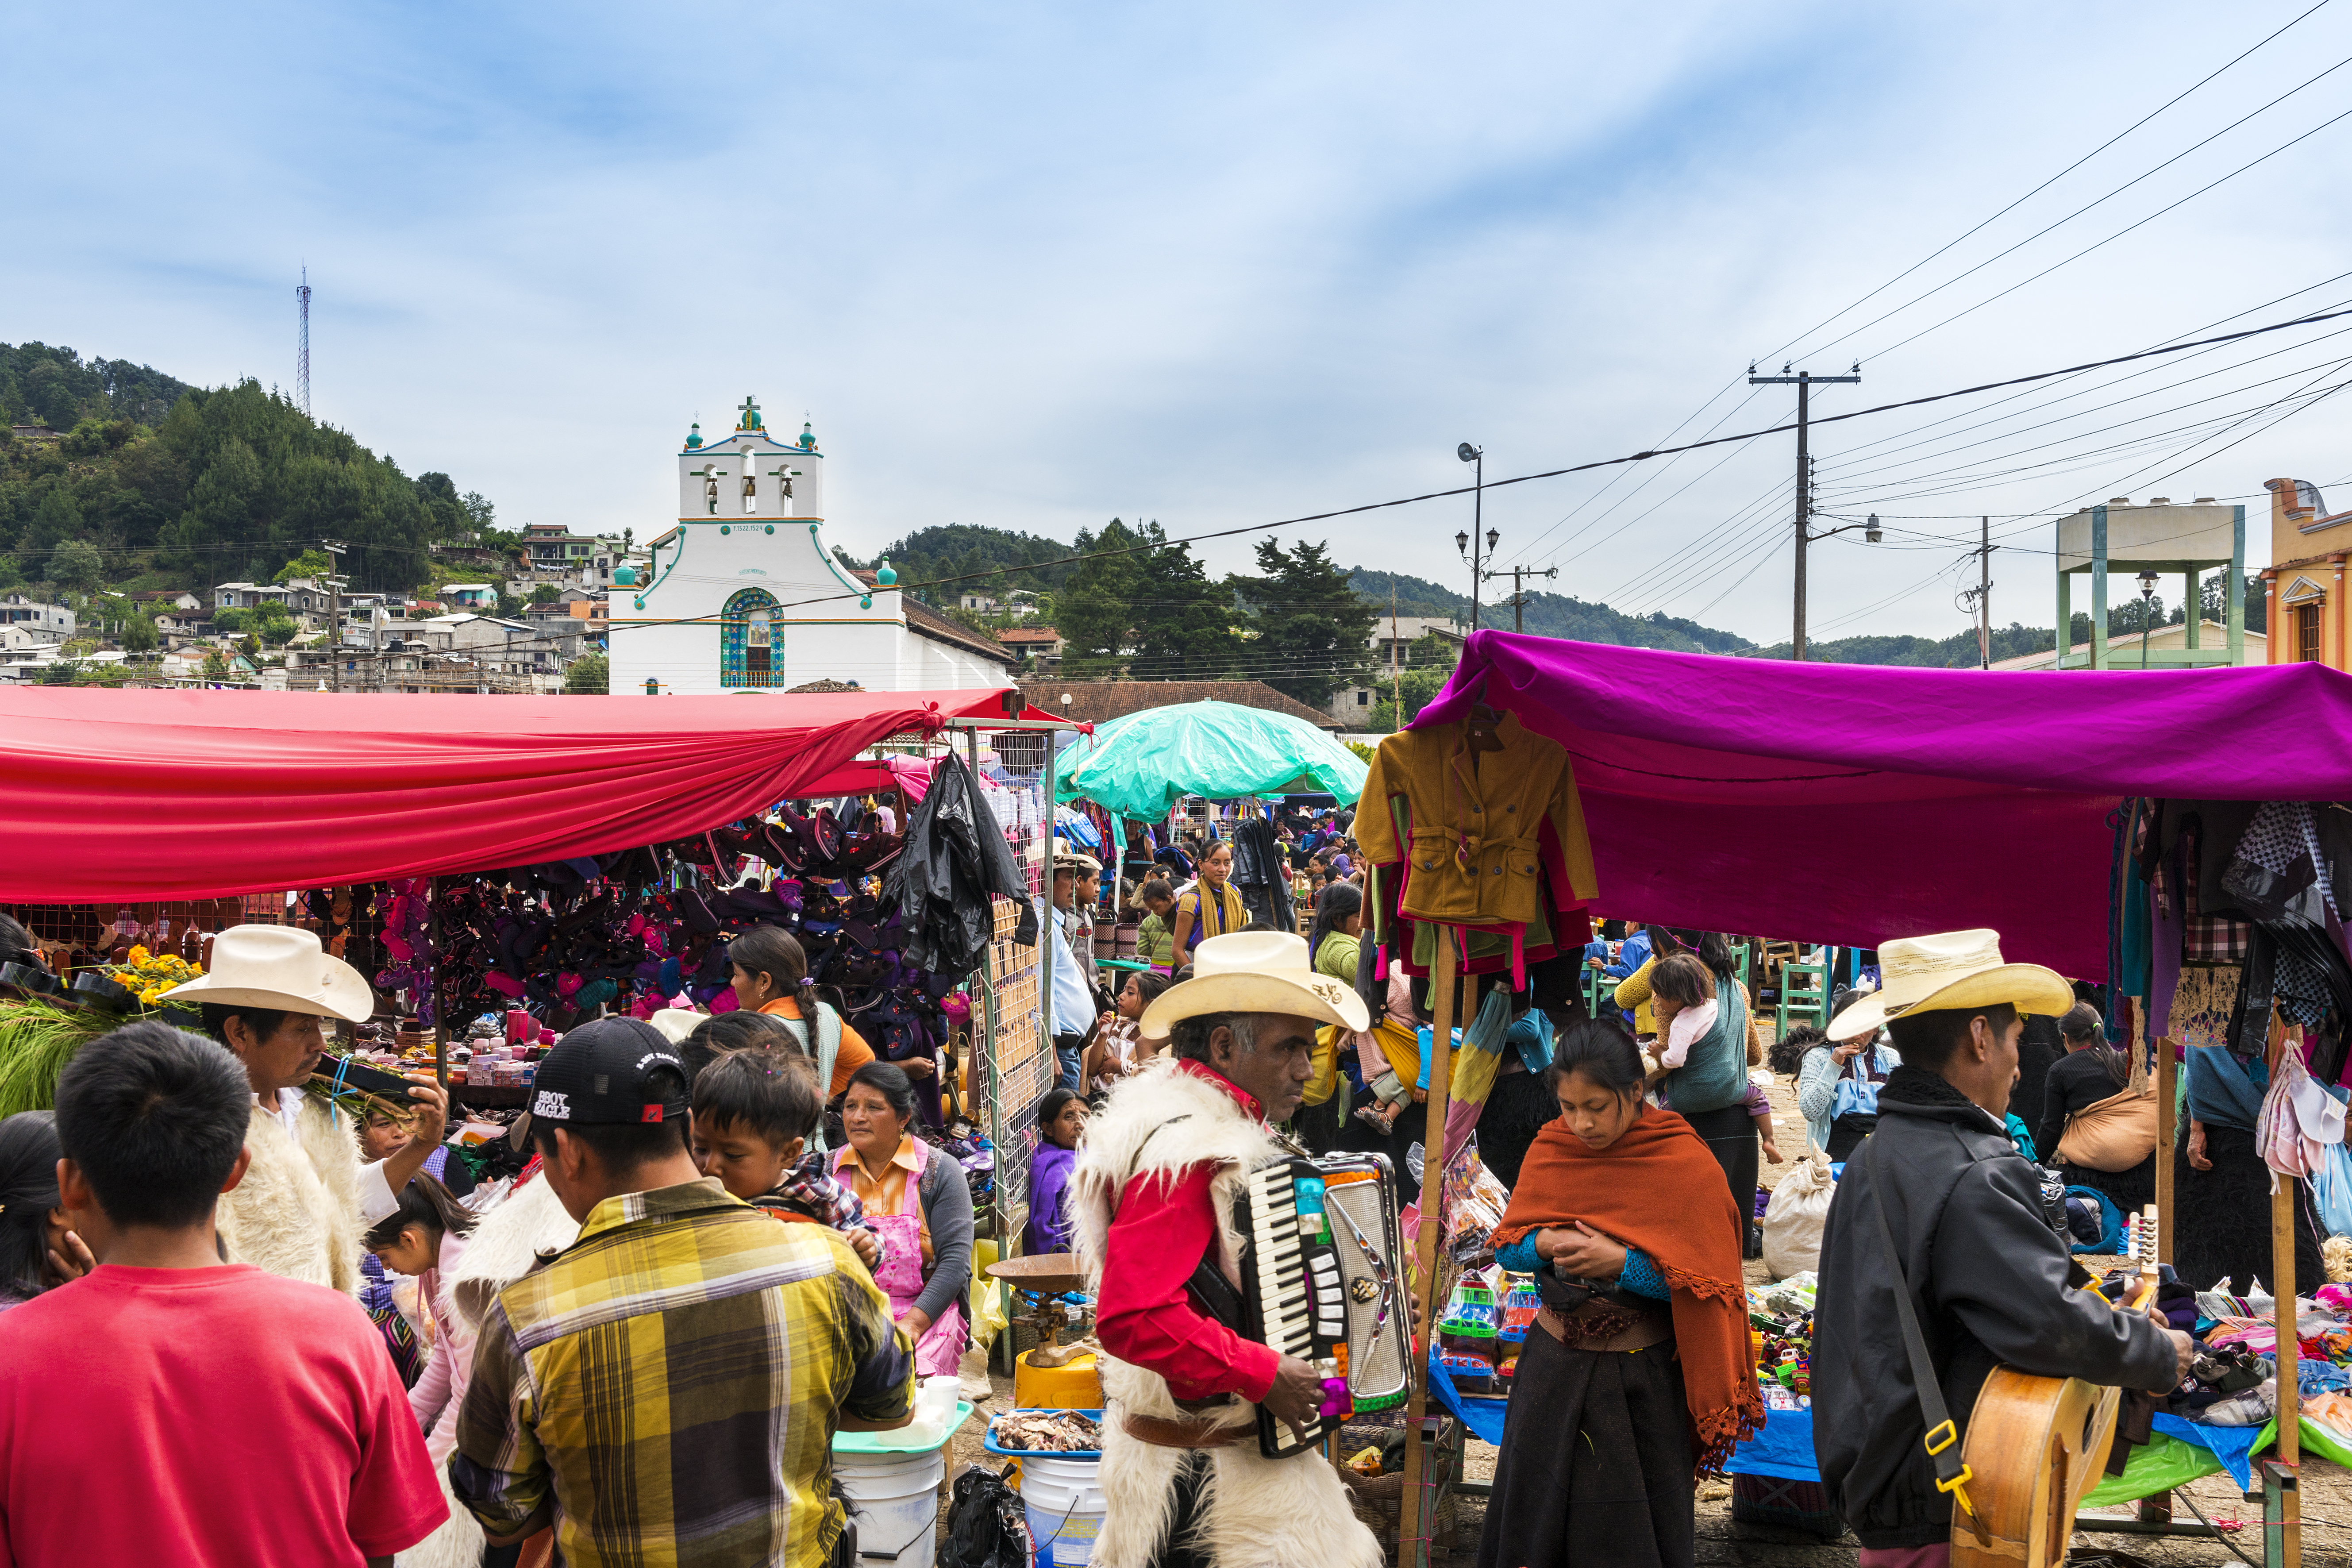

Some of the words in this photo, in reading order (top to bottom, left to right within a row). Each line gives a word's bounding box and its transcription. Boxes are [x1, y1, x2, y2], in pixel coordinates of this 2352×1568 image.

[636, 1053, 655, 1070] B-BOY
[655, 1052, 680, 1064] EAGLE
[538, 1090, 569, 1106] BBOY
[533, 1102, 570, 1119] EAGLE
